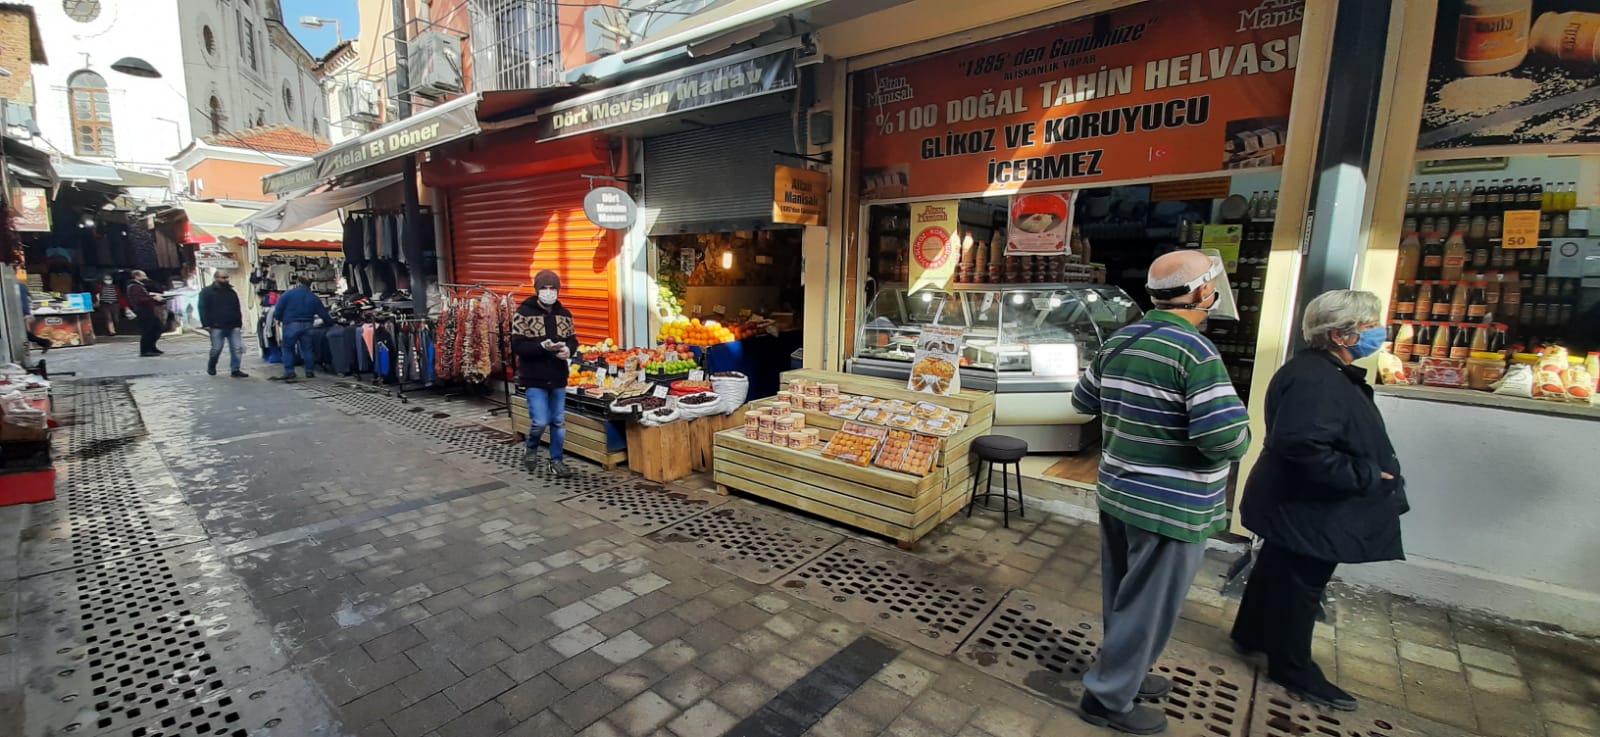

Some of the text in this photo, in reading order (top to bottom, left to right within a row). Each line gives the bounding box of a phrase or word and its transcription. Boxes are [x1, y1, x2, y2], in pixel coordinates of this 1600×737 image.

[552, 68, 763, 130] Dört Mevsim Manav
[876, 34, 1300, 135] %100 DOĞAL TAHİN HELVASI
[369, 141, 386, 159] Et
[388, 121, 441, 153] Döner
[921, 95, 1210, 160] GLİKOZ VE KORUYUCU
[988, 149, 1104, 187] İÇERMEZ
[1508, 237, 1526, 245] 50
